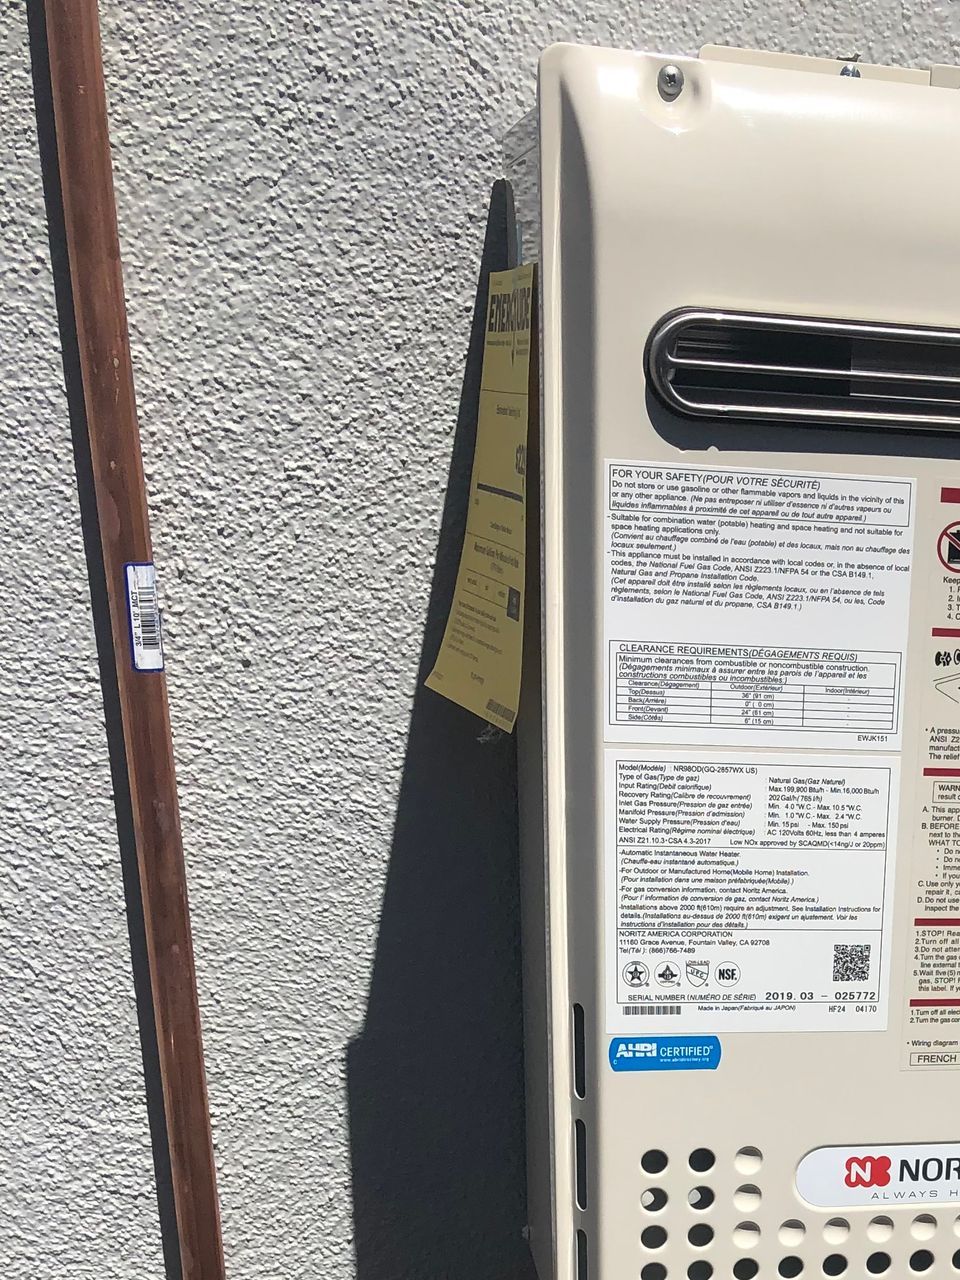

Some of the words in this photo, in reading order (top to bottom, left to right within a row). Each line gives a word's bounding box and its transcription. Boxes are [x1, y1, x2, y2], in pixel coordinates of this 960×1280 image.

[612, 468, 632, 478] FOR
[634, 470, 663, 480] YOUR
[665, 471, 733, 486] SAFETY(POUR
[736, 476, 768, 486] VOTRE
[770, 476, 820, 491] SÉCURITÉ)
[680, 484, 710, 494] gasoline
[740, 487, 776, 497] flammable
[777, 491, 801, 499] vapors
[817, 492, 839, 501] liquids
[848, 494, 859, 502] the
[860, 495, 883, 504] vicinity
[942, 576, 960, 587] Keep
[619, 643, 674, 654] CLEARANCE
[677, 646, 819, 660] REQUIREMENTS(DÉGAGEMENTS
[821, 652, 857, 662] REQUIS)
[857, 734, 887, 742] EWJK151
[800, 991, 813, 1000] 03
[834, 991, 875, 1000] 025772
[932, 1039, 958, 1047] diagram
[615, 1042, 657, 1057] AHRI
[917, 1054, 956, 1062] FRENCH
[870, 1190, 938, 1199] ALWAYS
